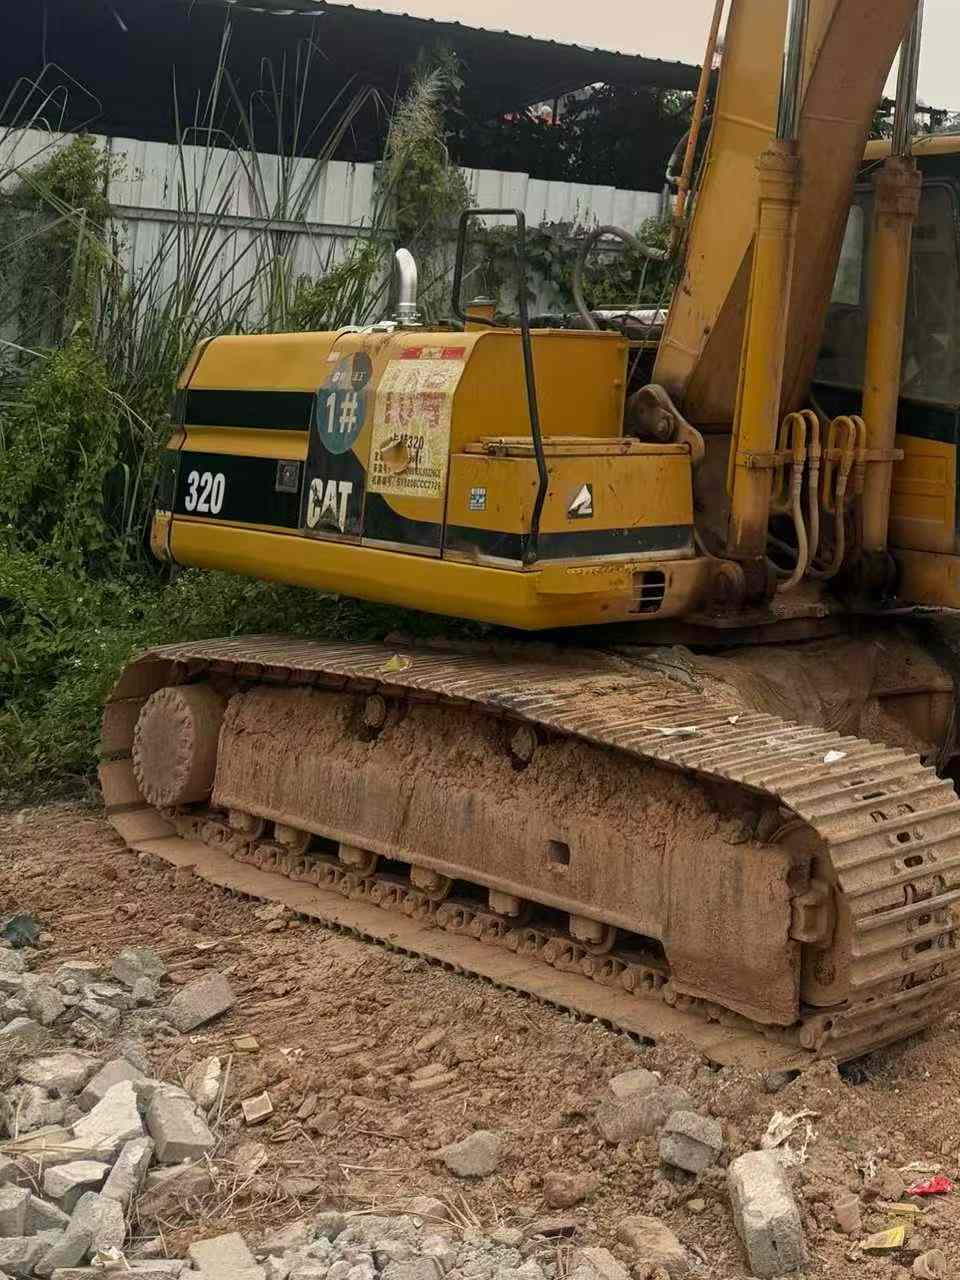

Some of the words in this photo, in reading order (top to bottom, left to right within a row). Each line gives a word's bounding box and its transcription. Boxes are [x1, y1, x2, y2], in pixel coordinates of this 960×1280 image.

[326, 392, 358, 433] 1#
[184, 470, 226, 515] 320
[306, 477, 353, 534] CAT
